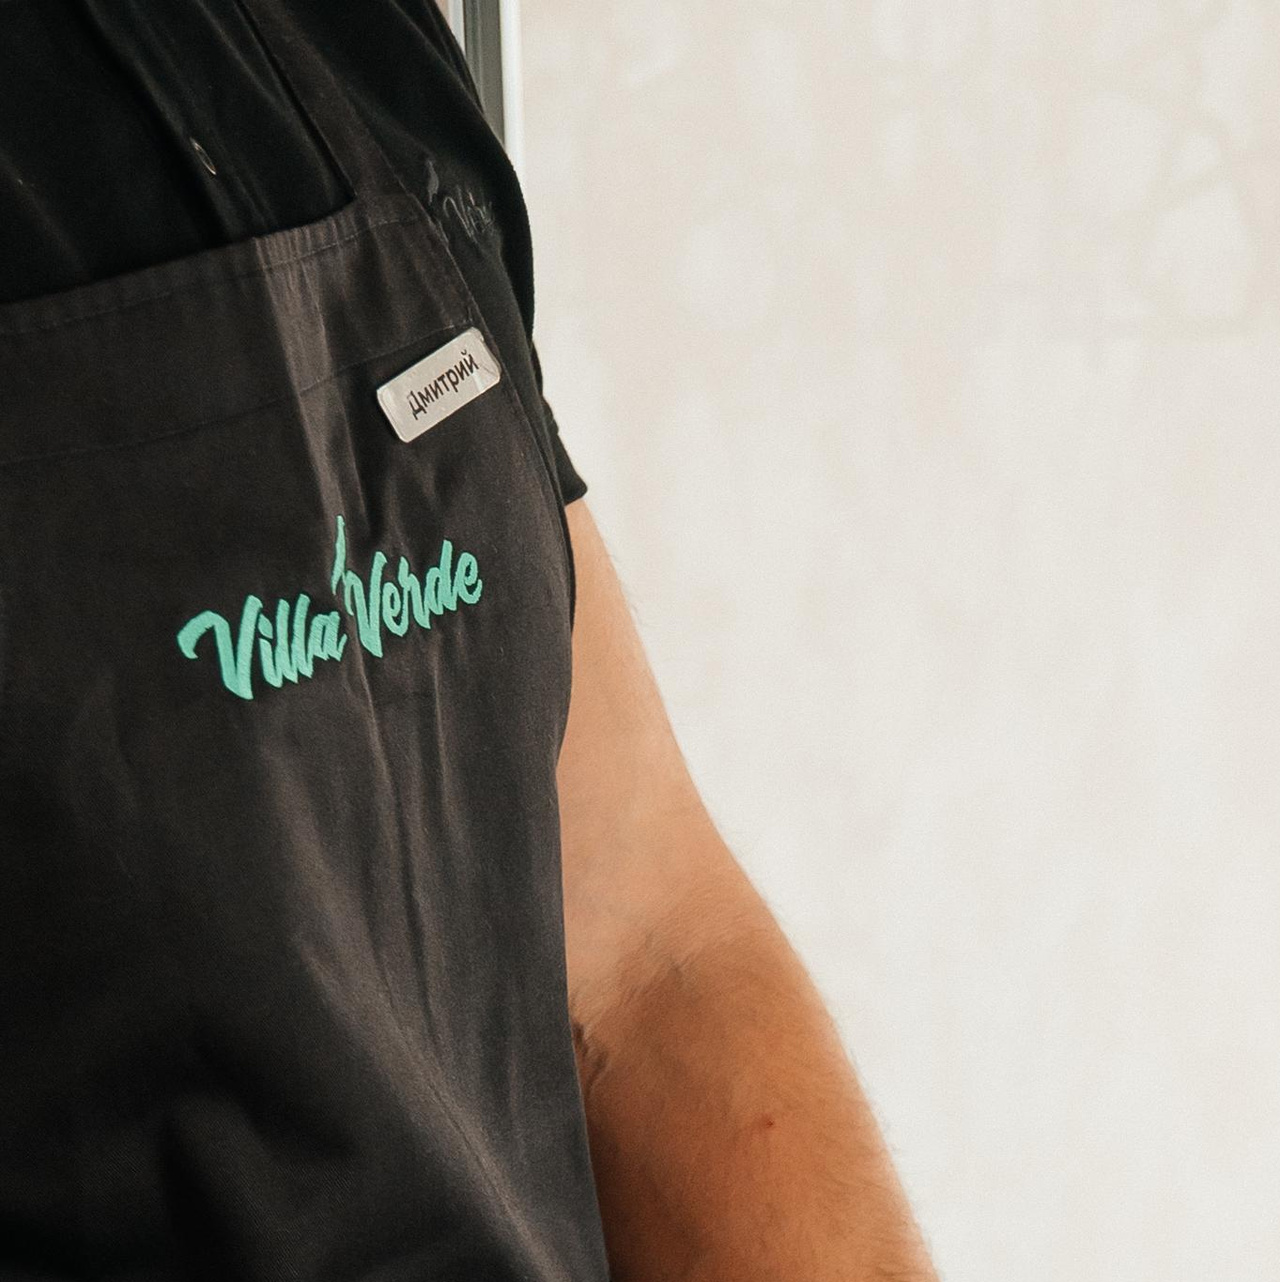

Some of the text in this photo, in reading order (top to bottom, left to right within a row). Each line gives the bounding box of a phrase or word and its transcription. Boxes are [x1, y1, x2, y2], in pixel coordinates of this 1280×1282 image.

[406, 349, 480, 421] Дмитрий
[177, 539, 483, 700] Villa Verde
